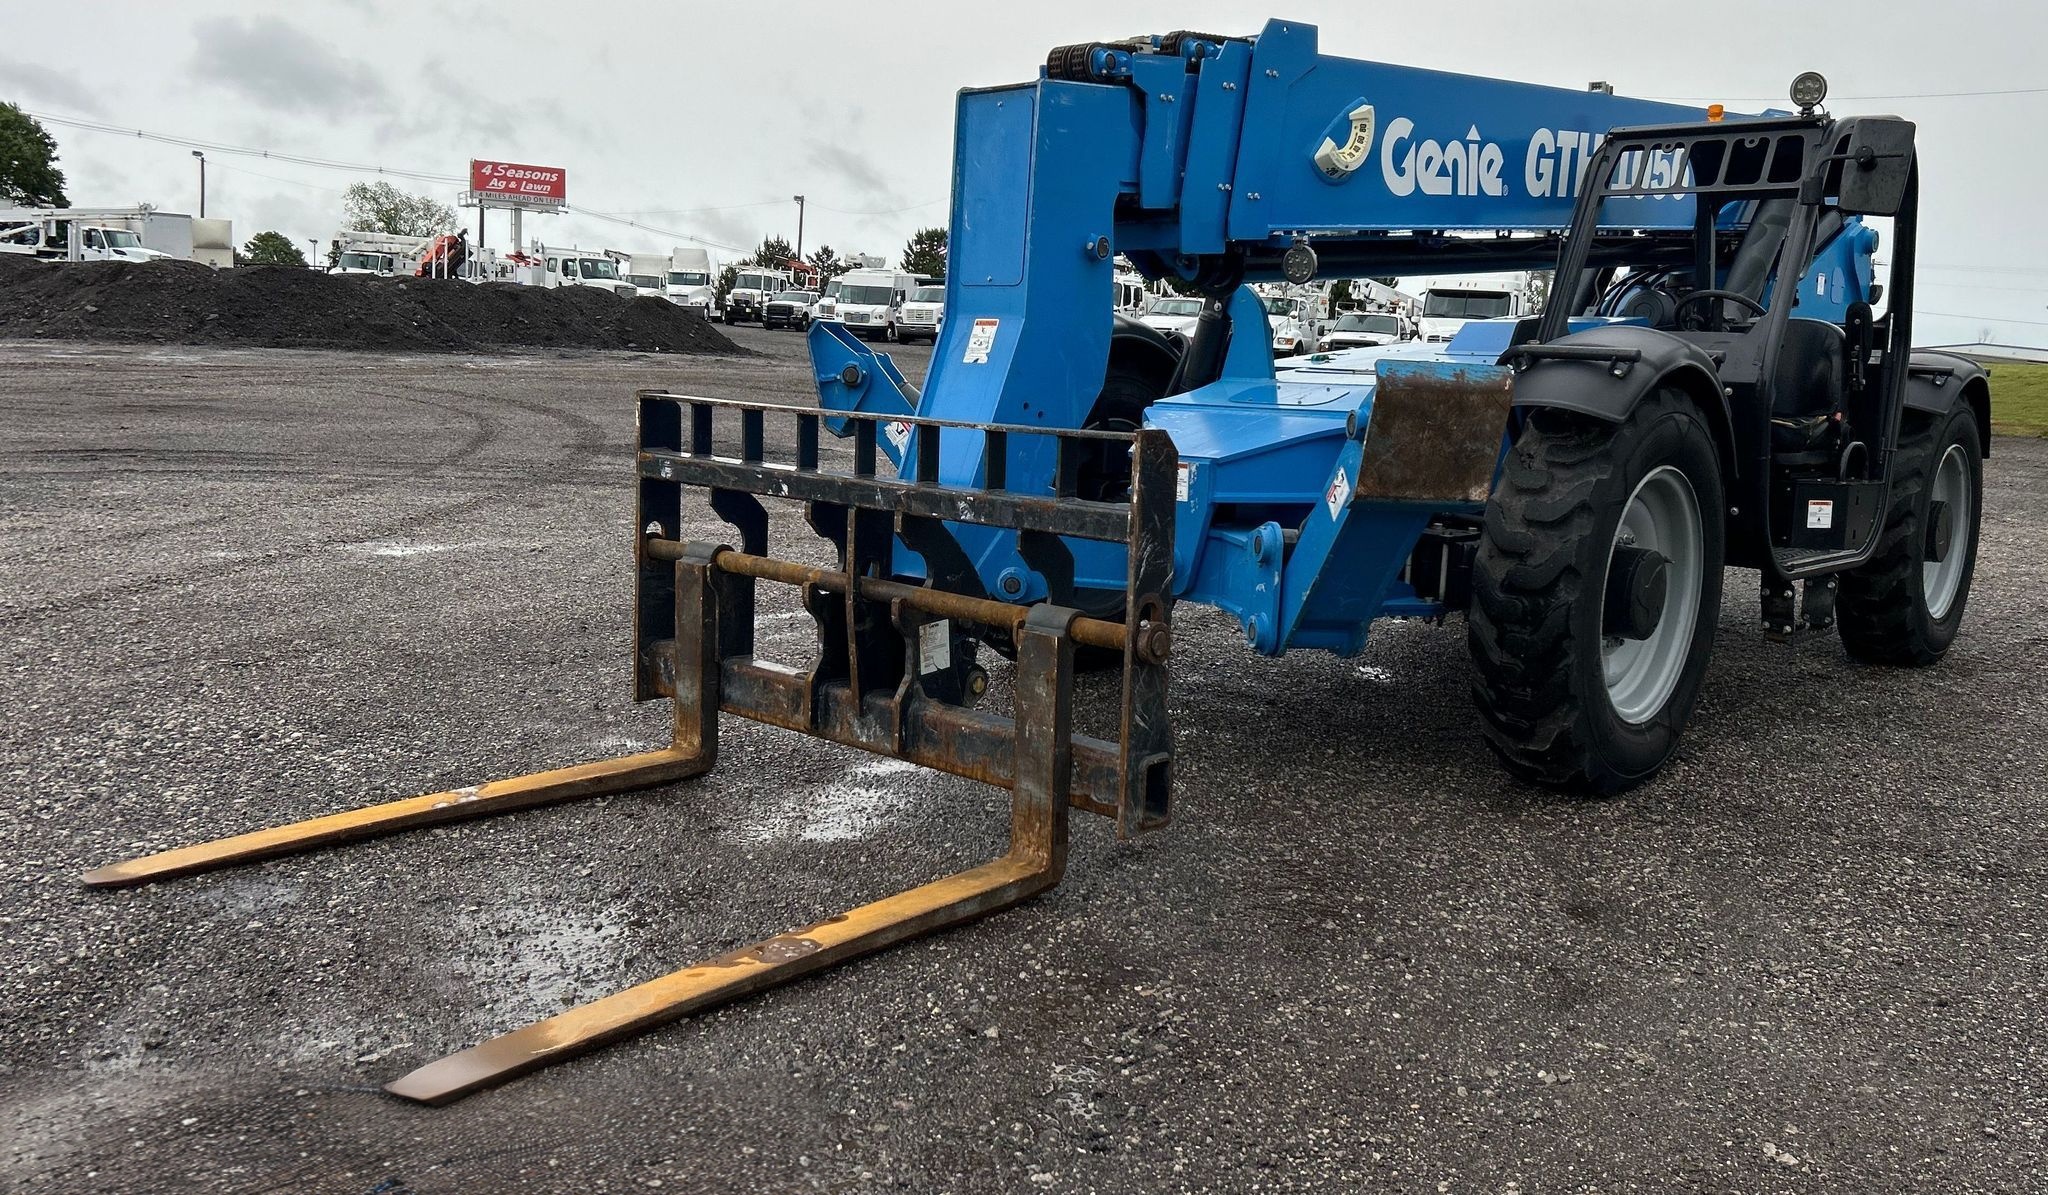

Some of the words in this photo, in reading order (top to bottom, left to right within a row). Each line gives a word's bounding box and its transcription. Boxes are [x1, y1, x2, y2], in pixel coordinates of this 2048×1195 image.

[1381, 118, 1504, 196] Genie
[481, 164, 492, 176] 4
[494, 164, 559, 182] Seasons
[488, 178, 507, 188] Ag
[508, 181, 518, 189] &
[520, 181, 551, 192] Lawn
[485, 192, 507, 200] MILES
[508, 194, 532, 202] AHEAD
